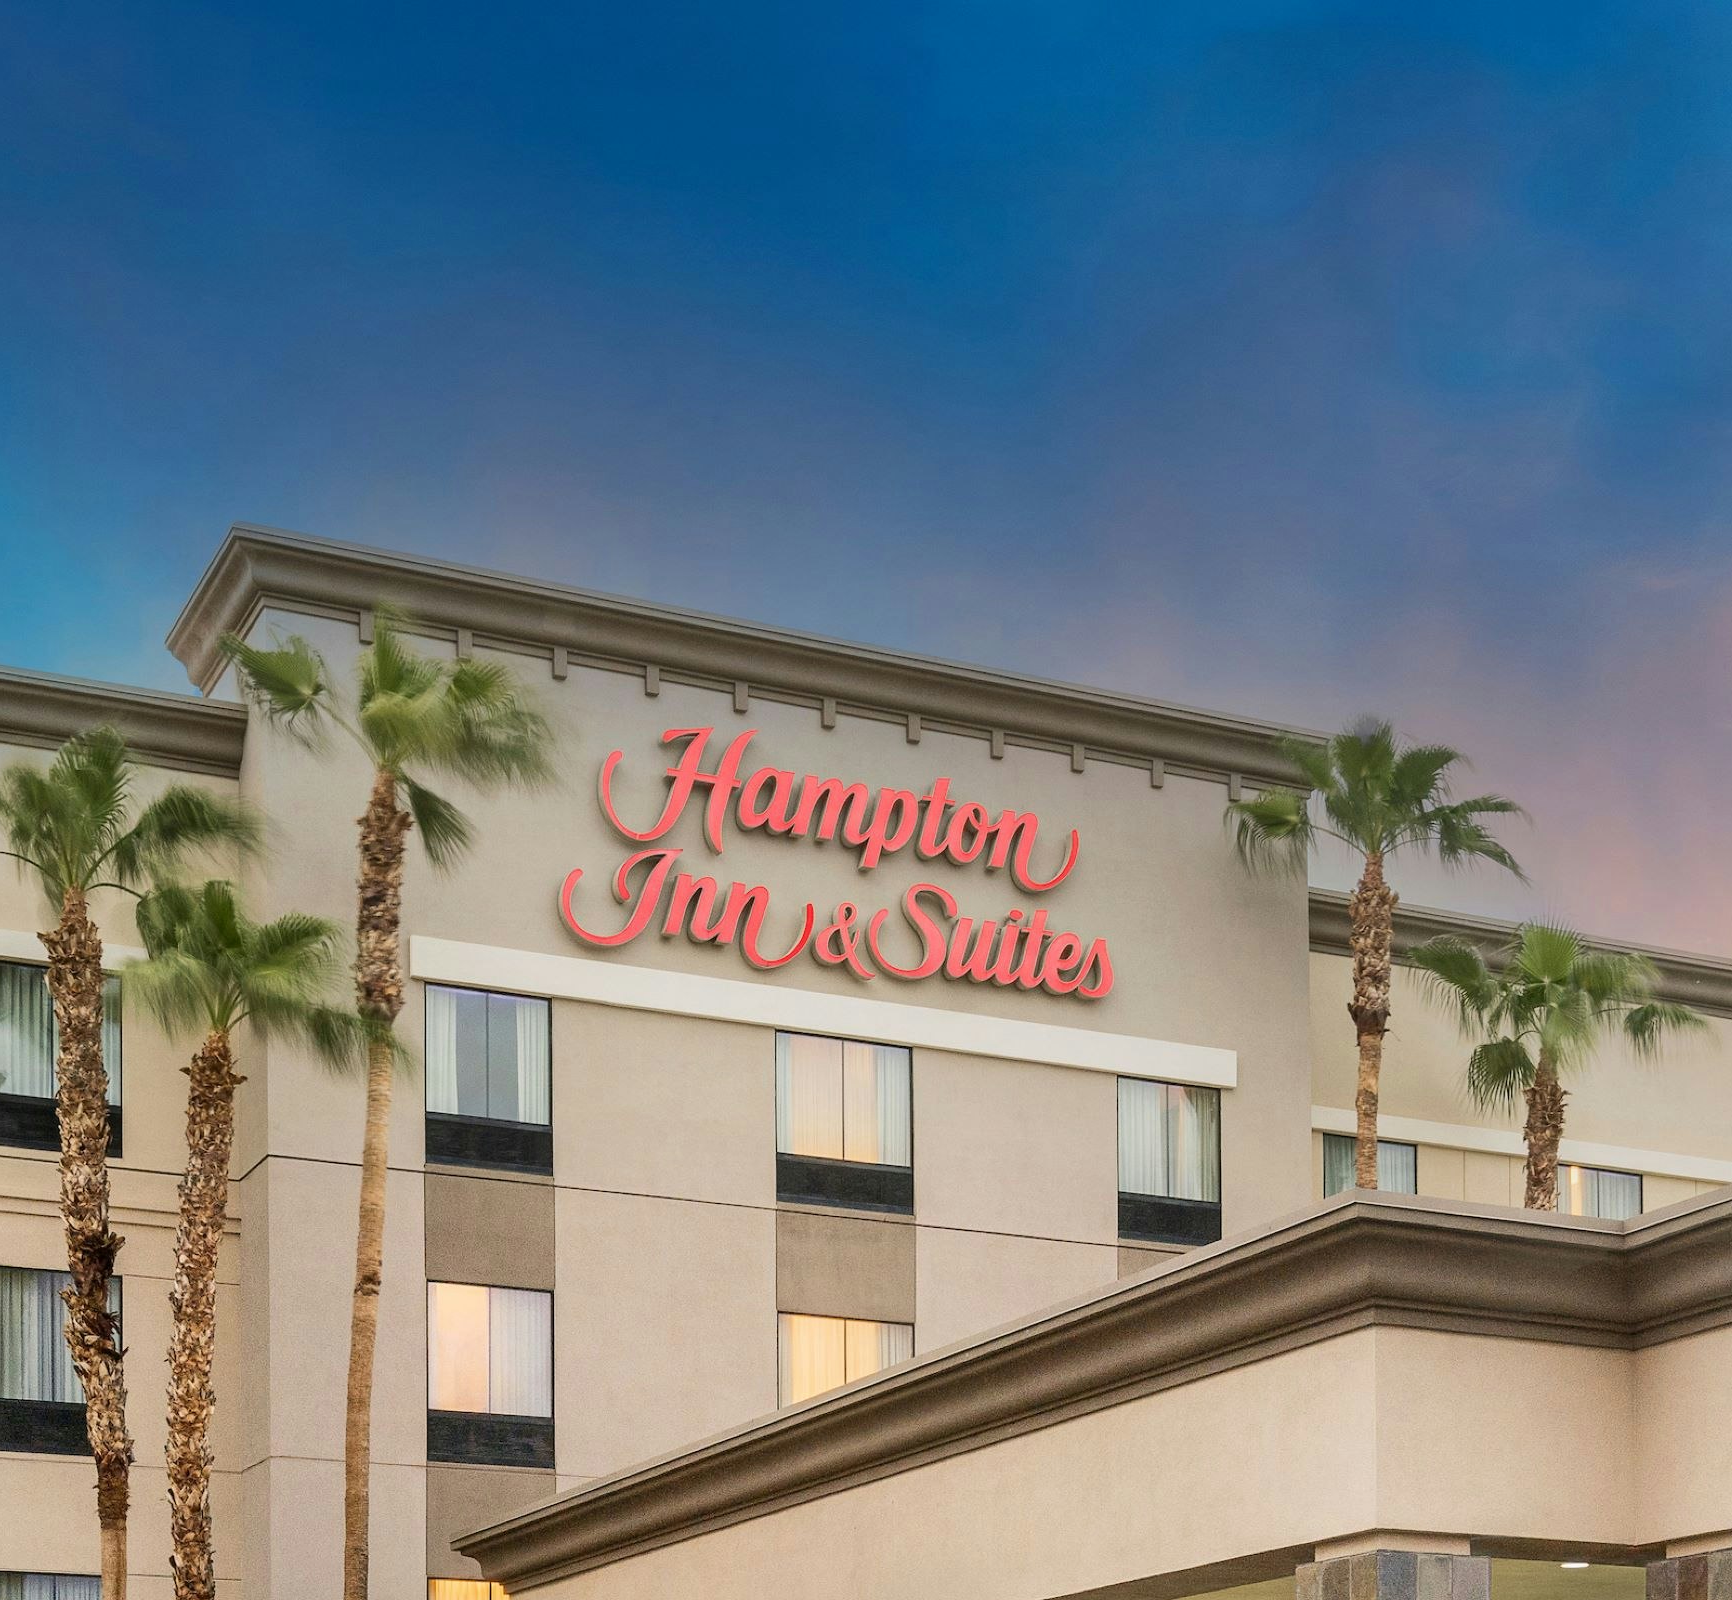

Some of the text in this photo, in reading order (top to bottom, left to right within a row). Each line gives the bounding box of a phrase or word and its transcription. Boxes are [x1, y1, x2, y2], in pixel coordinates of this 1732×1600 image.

[599, 726, 1080, 892] Hampton
[559, 848, 1115, 999] Inn & Suites
